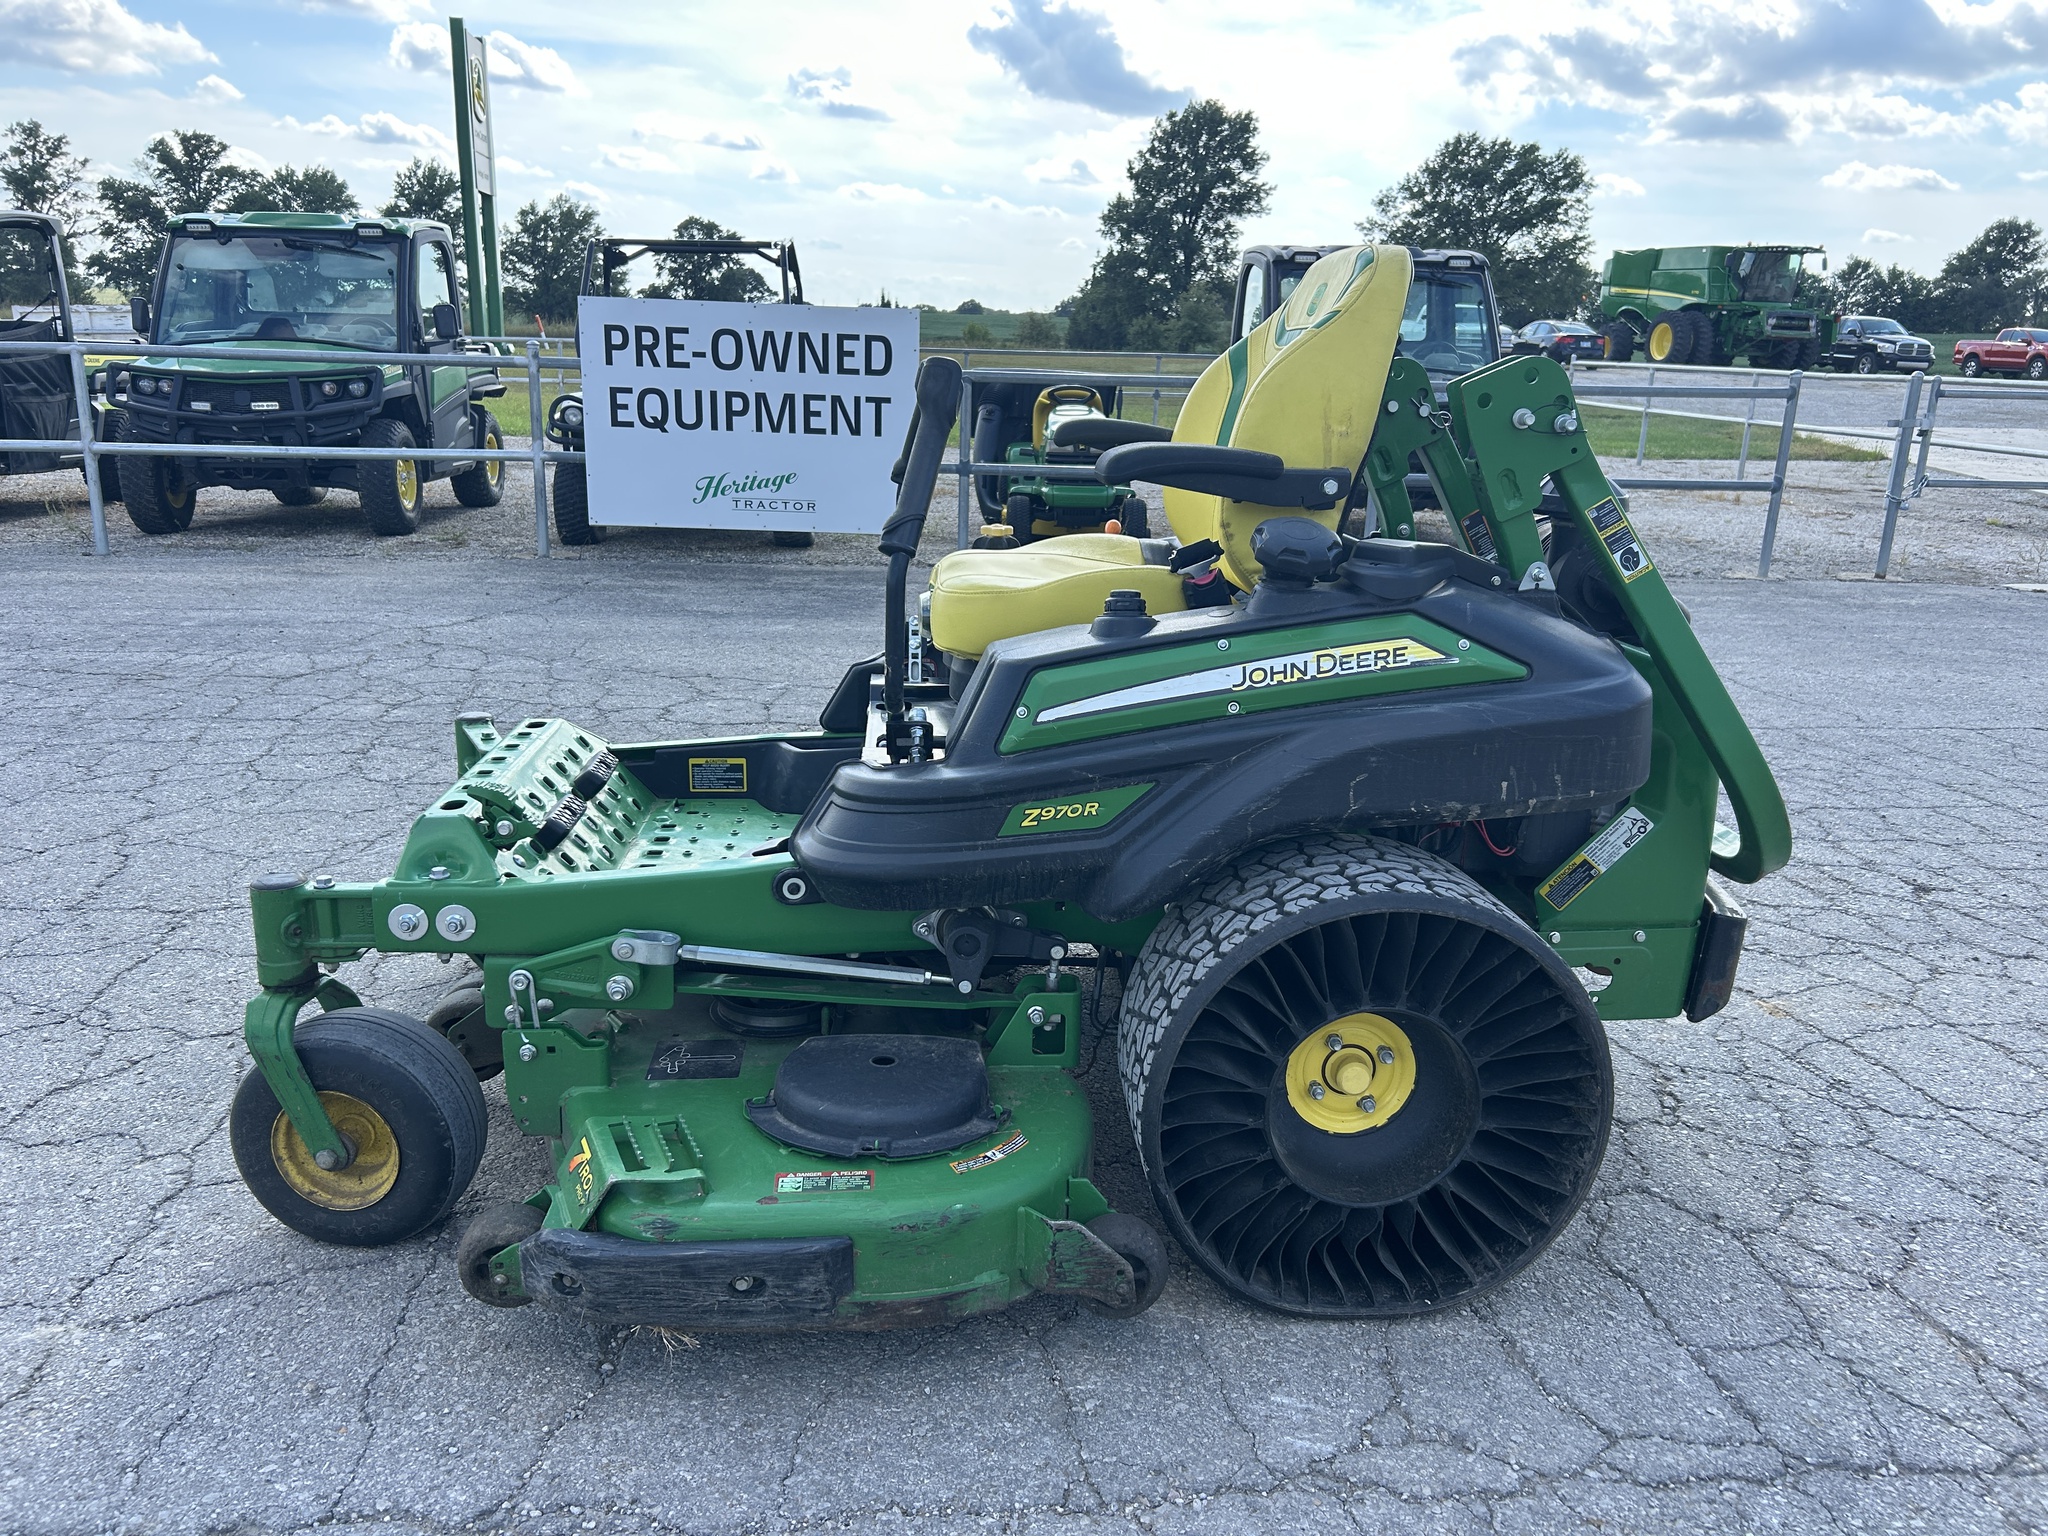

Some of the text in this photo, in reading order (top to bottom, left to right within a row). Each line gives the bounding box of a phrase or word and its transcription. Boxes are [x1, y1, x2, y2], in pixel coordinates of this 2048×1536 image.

[603, 323, 893, 377] PRE-OWNED
[609, 386, 892, 437] EQUIPMENT
[692, 471, 799, 504] Heritage
[732, 499, 816, 511] TRACTOR
[1232, 646, 1409, 688] JOHN DEERE
[1020, 802, 1100, 827] Z970R
